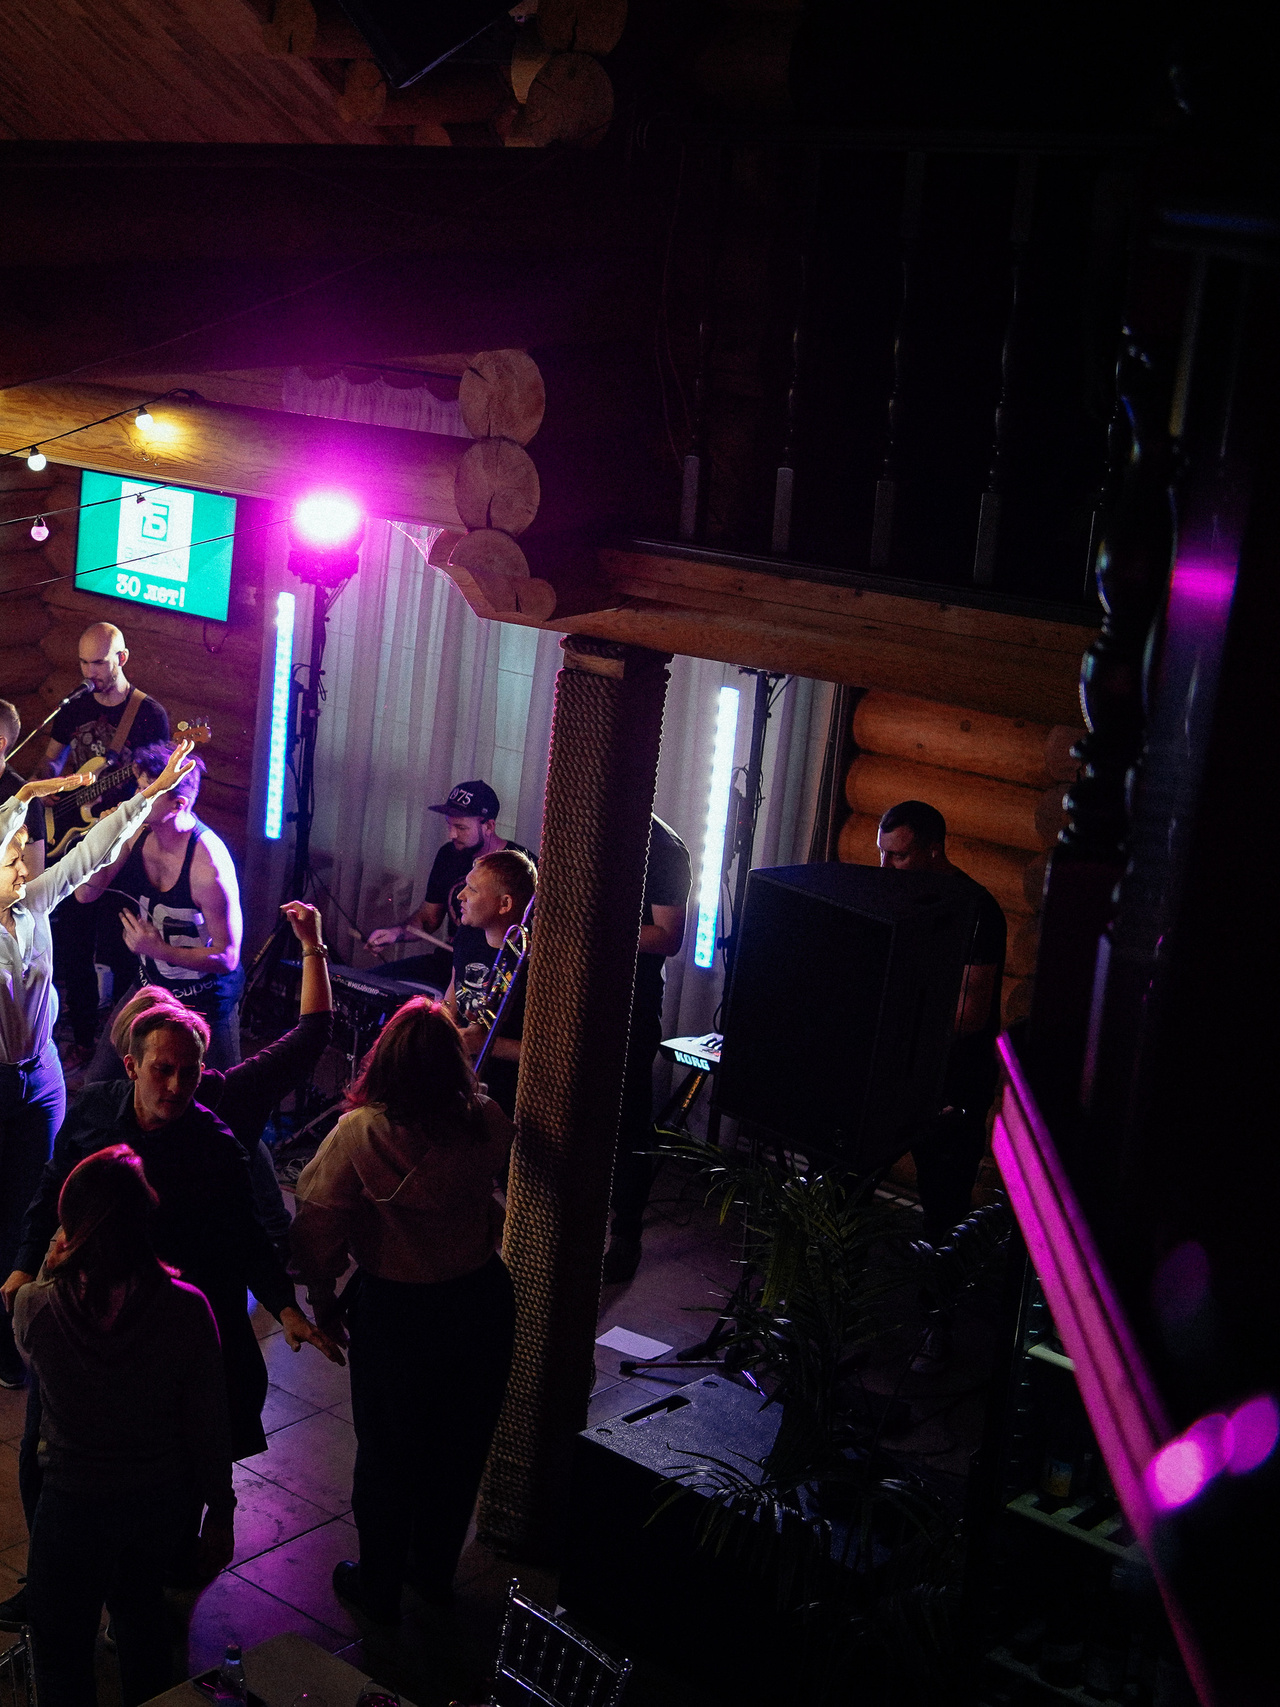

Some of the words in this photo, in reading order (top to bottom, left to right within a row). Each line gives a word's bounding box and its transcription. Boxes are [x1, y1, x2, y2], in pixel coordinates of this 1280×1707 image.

[116, 573, 141, 597] 30
[143, 584, 186, 607] лет!
[673, 1050, 711, 1071] KORG
